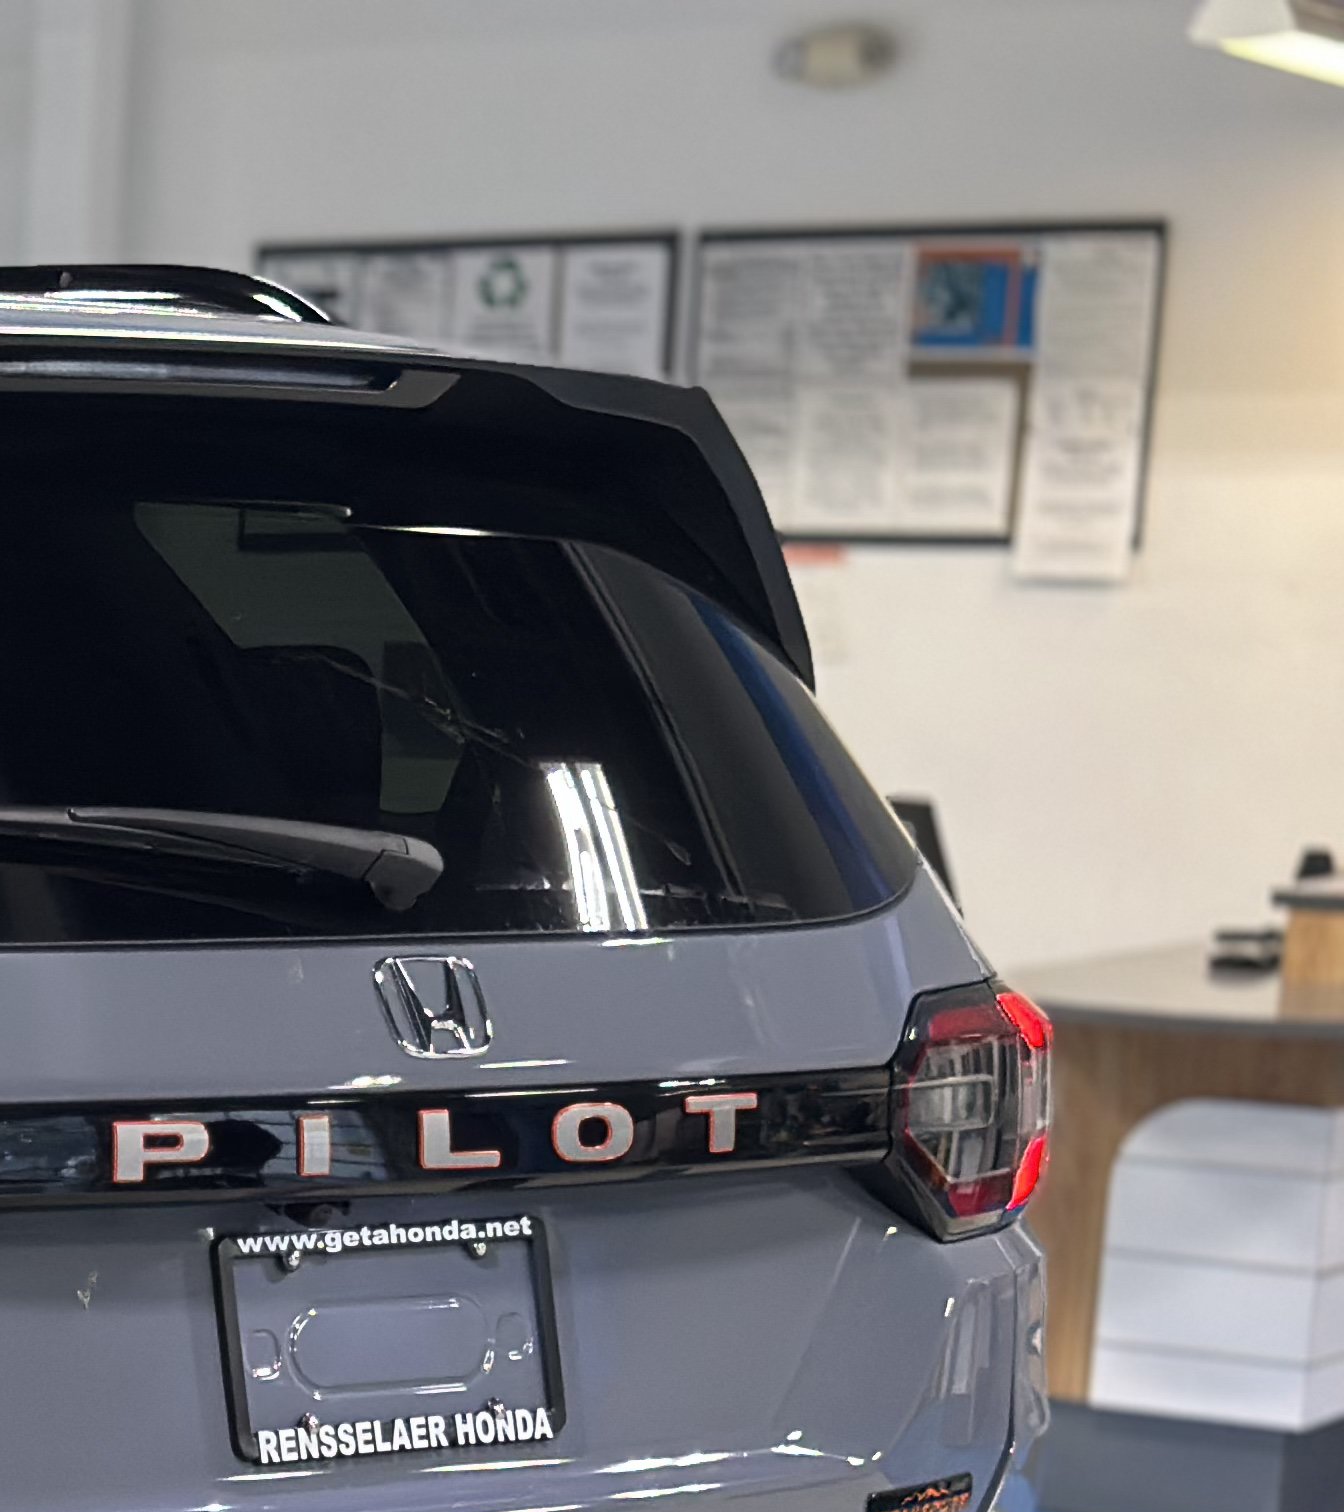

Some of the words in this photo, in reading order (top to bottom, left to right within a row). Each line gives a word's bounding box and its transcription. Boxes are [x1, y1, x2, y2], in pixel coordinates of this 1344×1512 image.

[112, 1092, 759, 1183] PILOT
[236, 1215, 534, 1254] www.getahonda.net
[257, 1417, 450, 1464] RENSSELAER
[454, 1406, 555, 1447] HONDA
